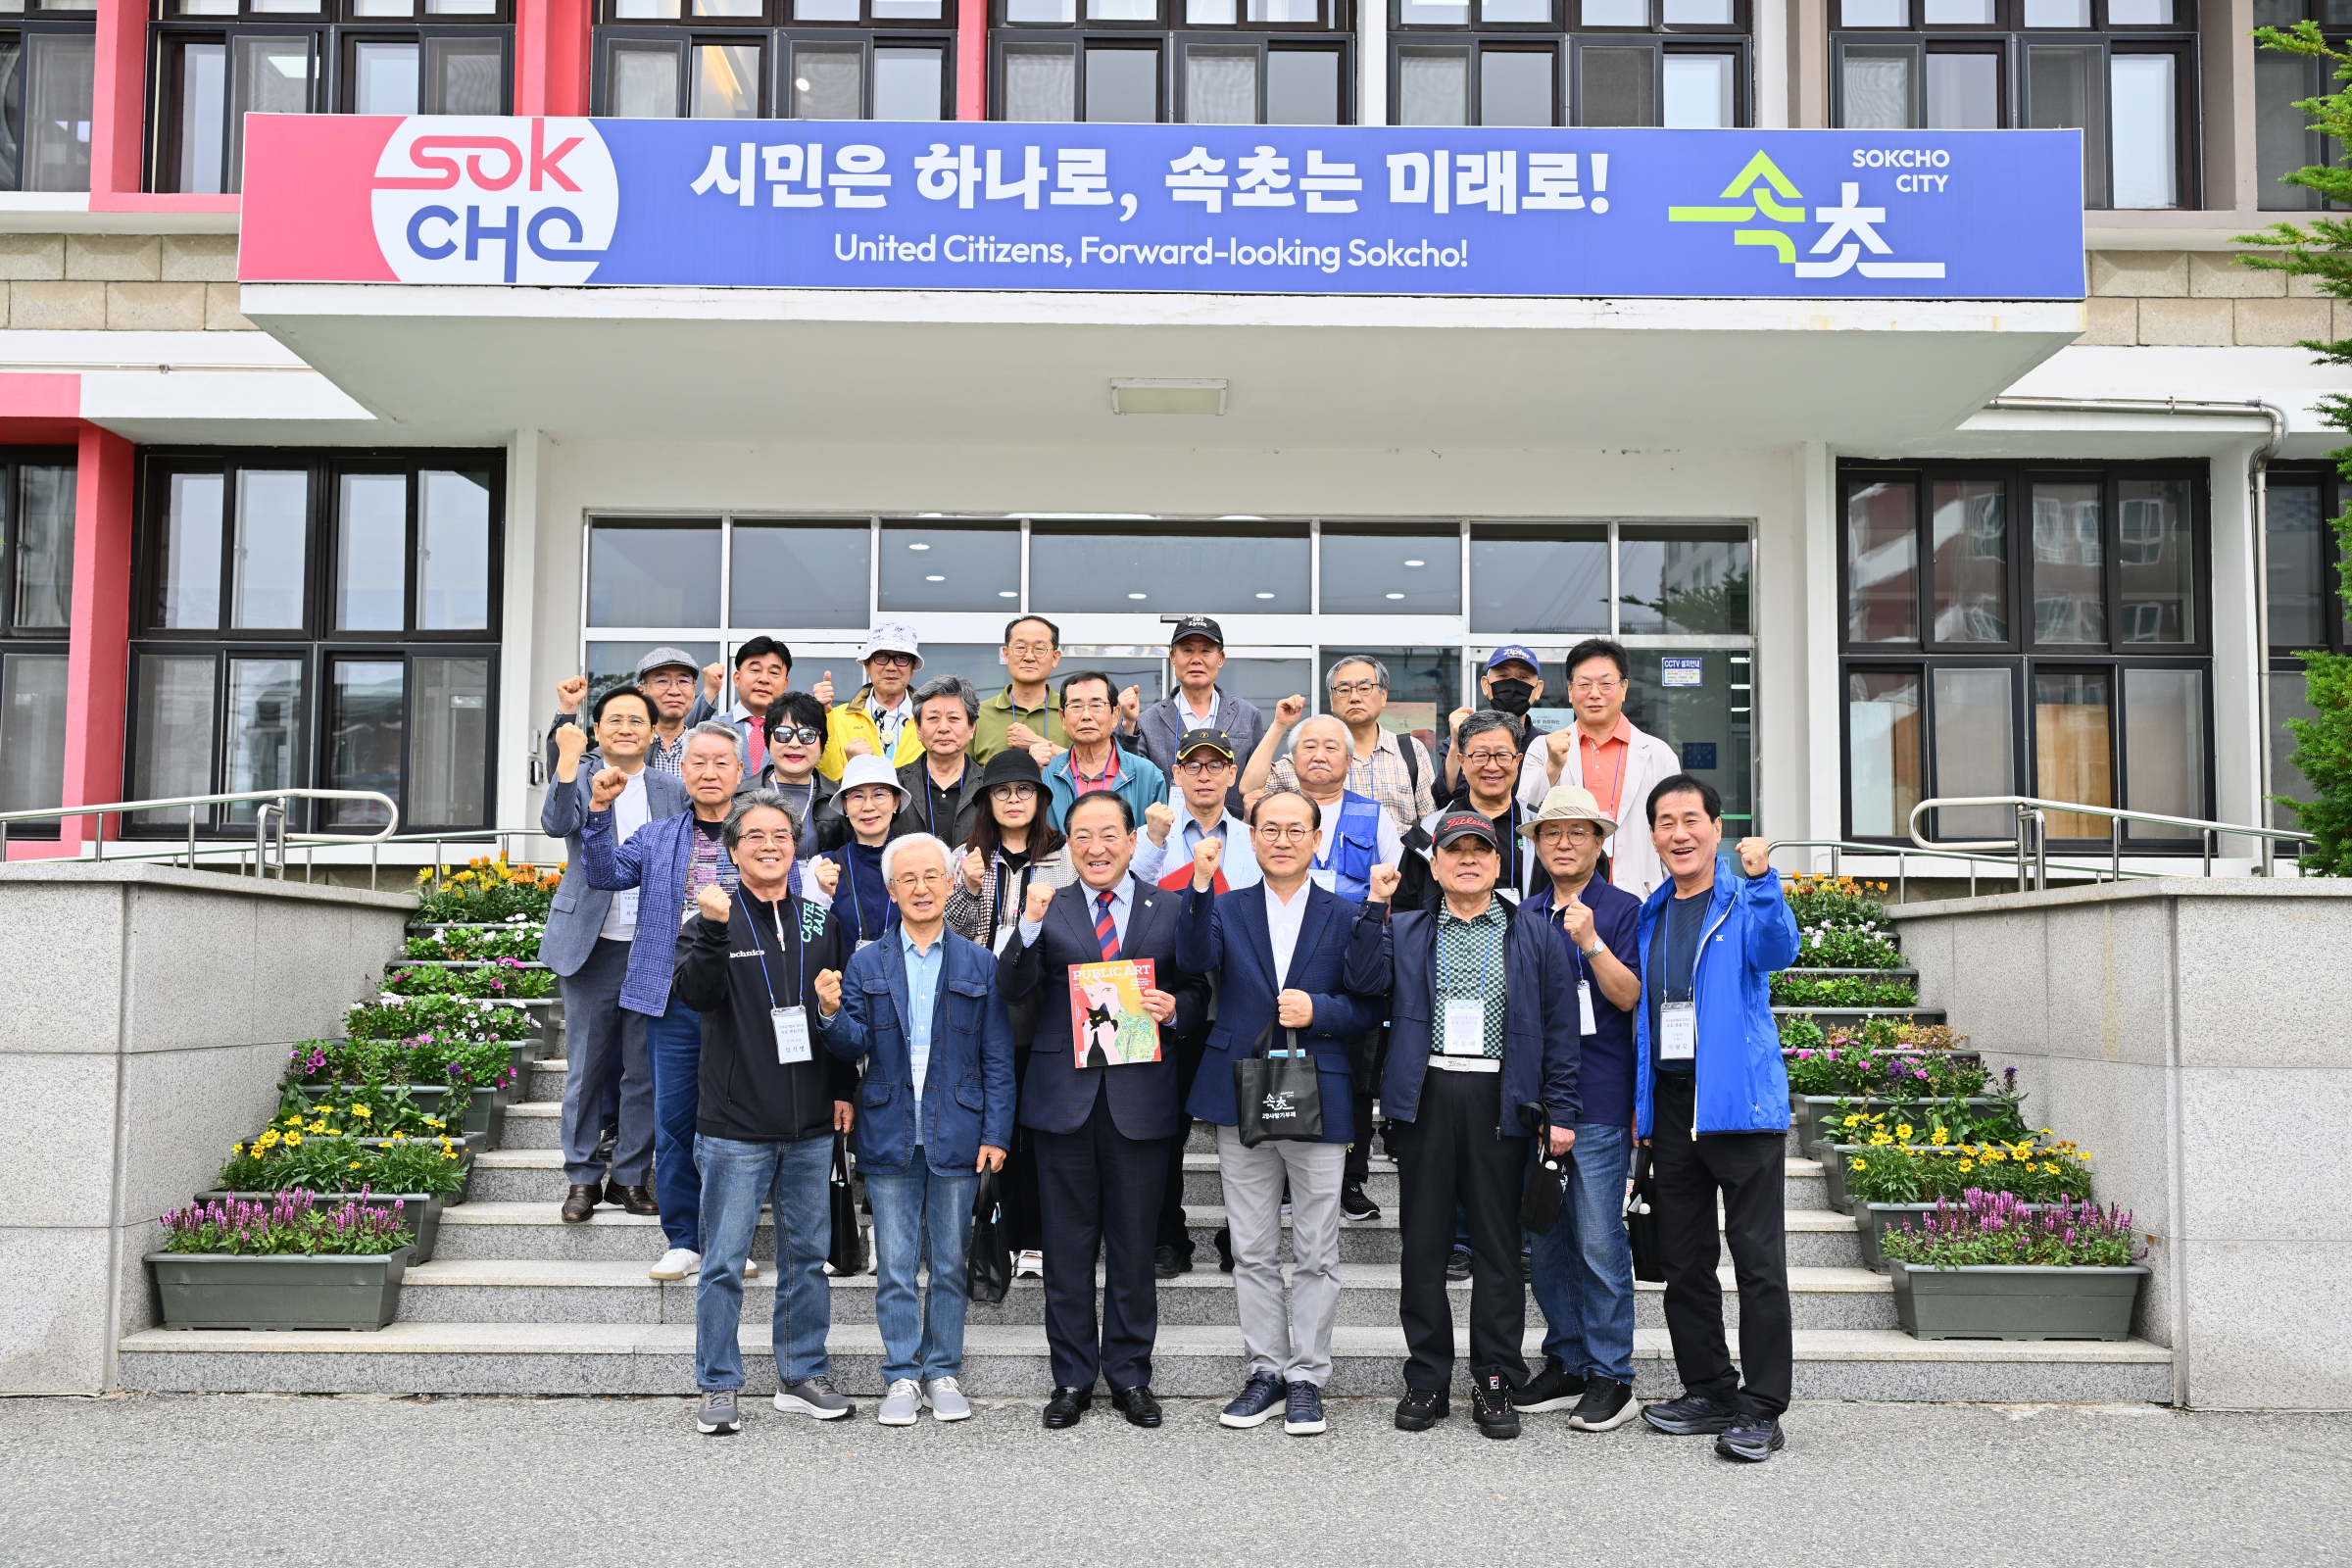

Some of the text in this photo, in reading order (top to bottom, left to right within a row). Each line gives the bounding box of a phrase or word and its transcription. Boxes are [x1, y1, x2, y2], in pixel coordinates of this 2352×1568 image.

[1852, 149, 1950, 169] SOKCHO
[690, 143, 1608, 221] 시민은 하나로, 속초는 미래로!
[1895, 174, 1949, 193] CITY
[1669, 149, 1947, 279] 속초
[835, 233, 1468, 273] United Citizens, Forward-looking Sokcho!
[1664, 660, 1700, 668] CCTV 설치안내
[1443, 815, 1492, 831] Titleist
[801, 902, 815, 943] CASTEL
[1072, 964, 1151, 981] PUBLIC ART
[1262, 1092, 1296, 1111] 속초
